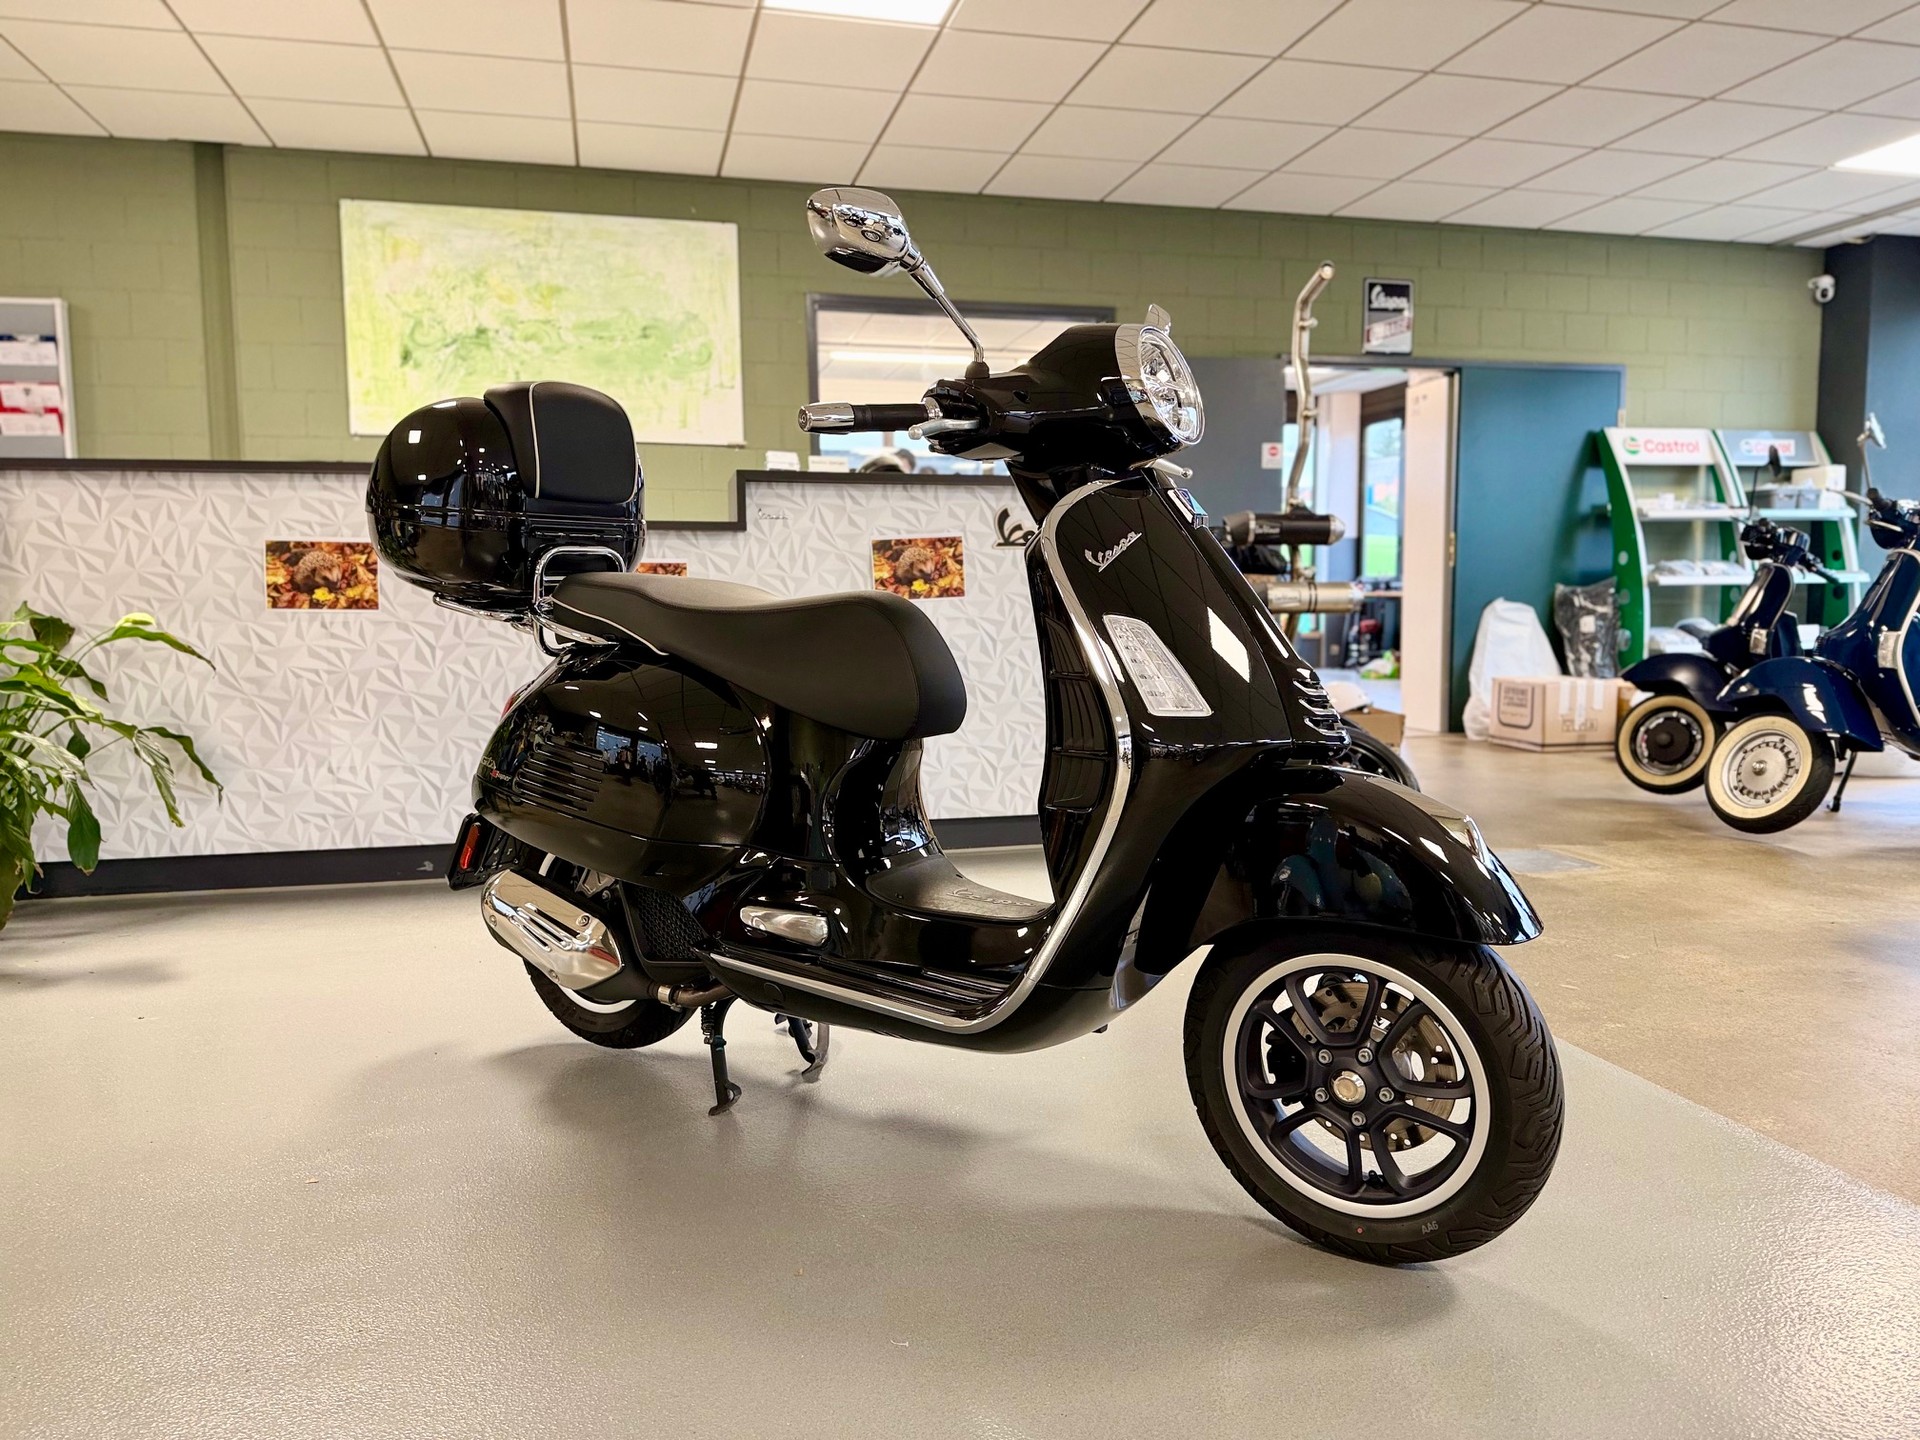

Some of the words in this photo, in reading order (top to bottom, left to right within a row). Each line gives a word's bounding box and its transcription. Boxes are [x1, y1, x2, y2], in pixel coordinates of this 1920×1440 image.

[1644, 439, 1699, 454] Castrol
[1754, 441, 1793, 454] Carol
[1084, 531, 1142, 573] Vespa
